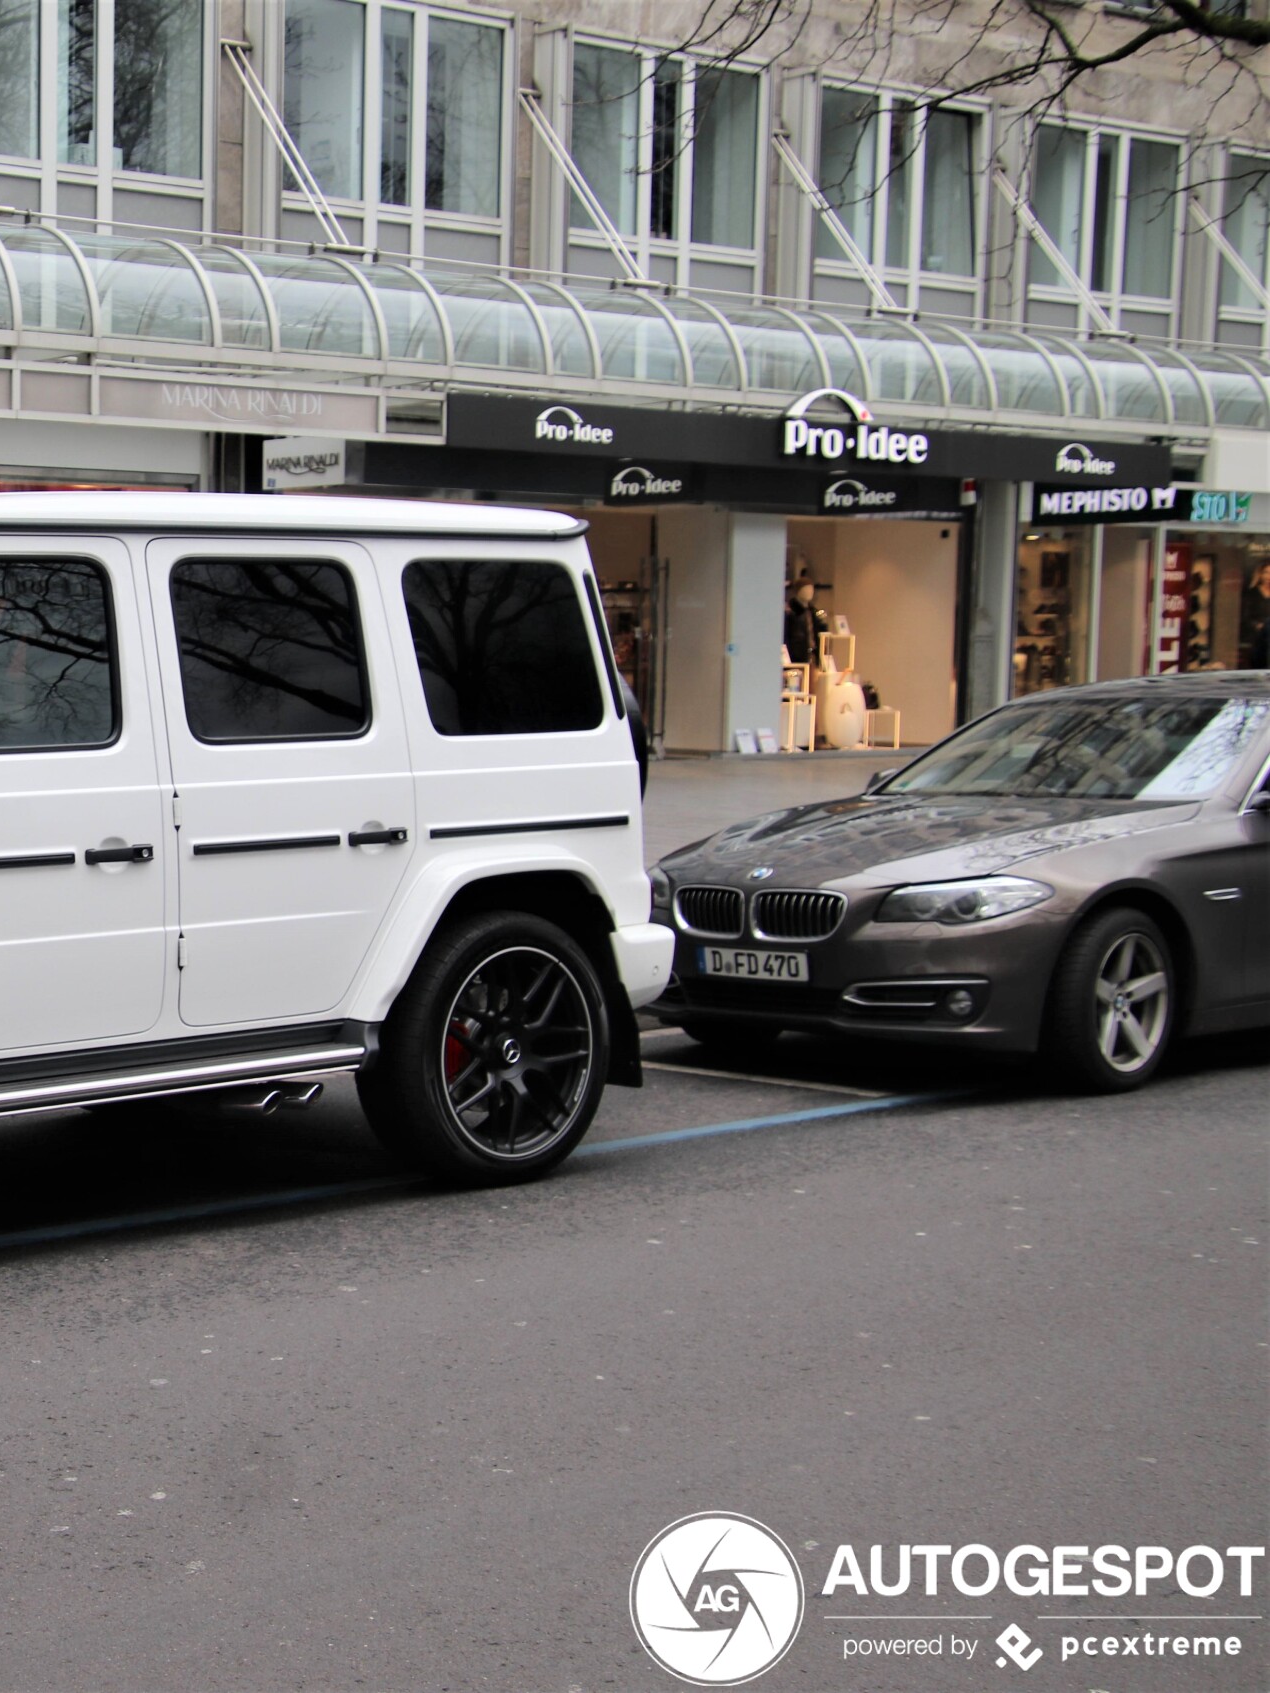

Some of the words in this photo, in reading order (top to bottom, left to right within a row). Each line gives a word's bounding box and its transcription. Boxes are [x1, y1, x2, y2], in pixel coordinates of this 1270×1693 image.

[162, 384, 240, 421] MARINA
[248, 390, 322, 423] RINALDI
[267, 455, 302, 475] MARINA
[303, 452, 340, 474] RINALDI
[1040, 487, 1148, 515] MEPHISTO
[712, 950, 723, 972] D
[734, 952, 758, 974] FD
[763, 954, 800, 978] 470
